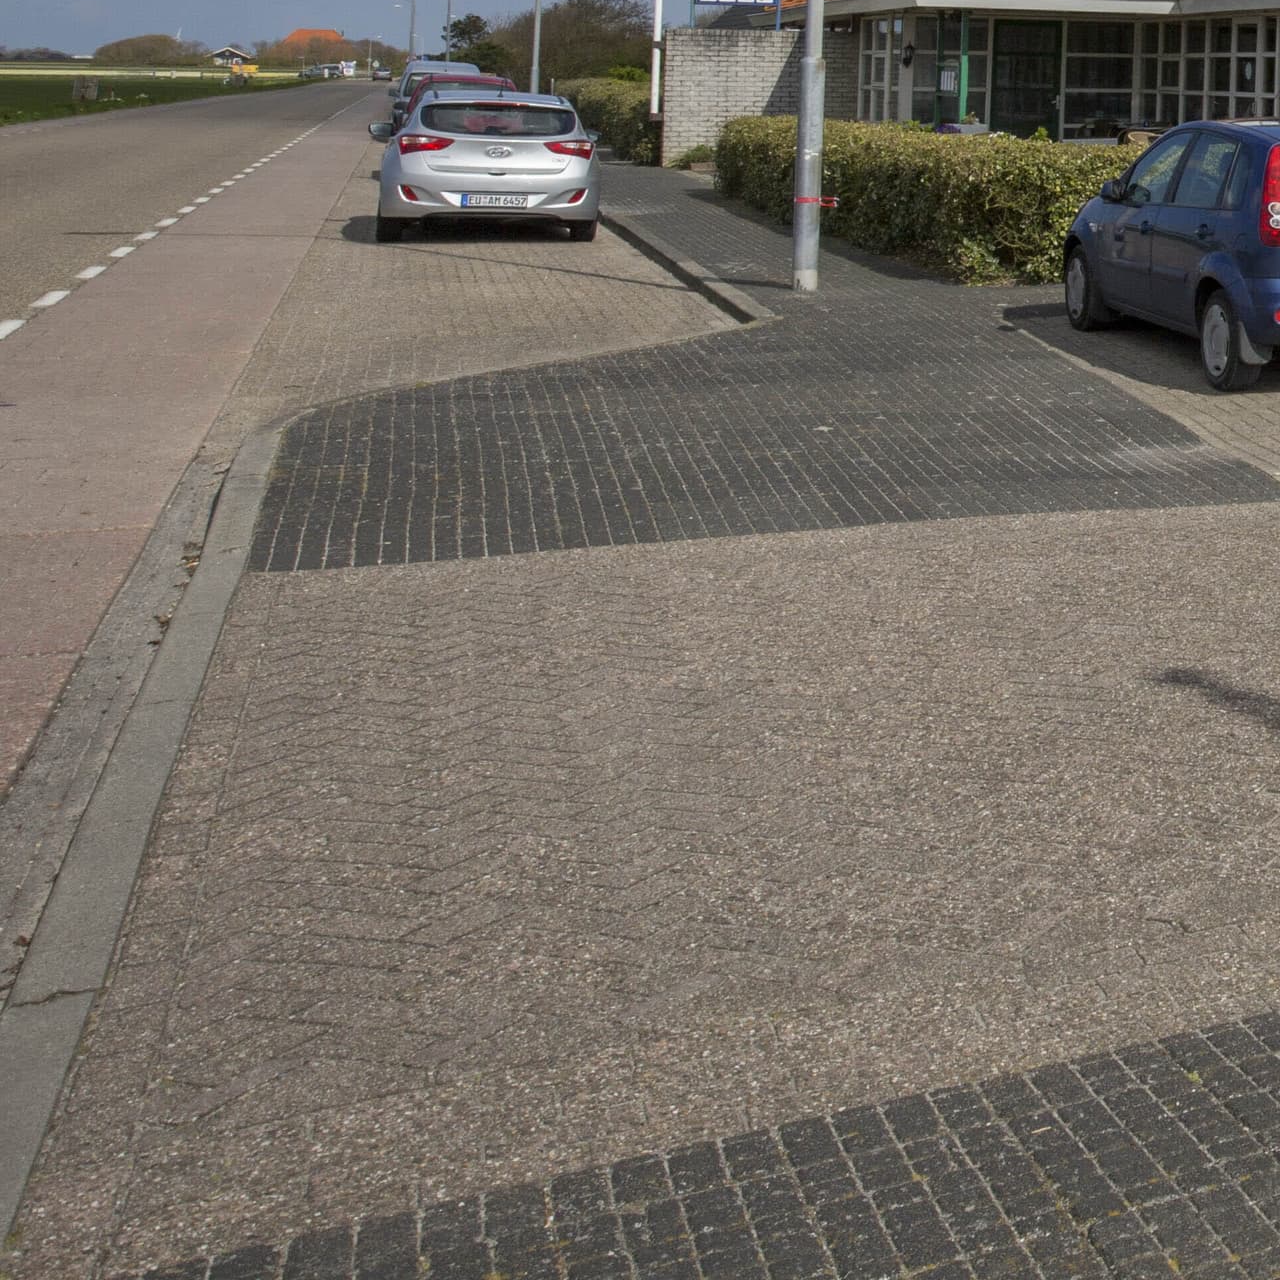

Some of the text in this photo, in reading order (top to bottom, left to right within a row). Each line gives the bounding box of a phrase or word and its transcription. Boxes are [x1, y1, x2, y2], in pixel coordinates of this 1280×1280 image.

[468, 195, 527, 206] EU AM 6457
